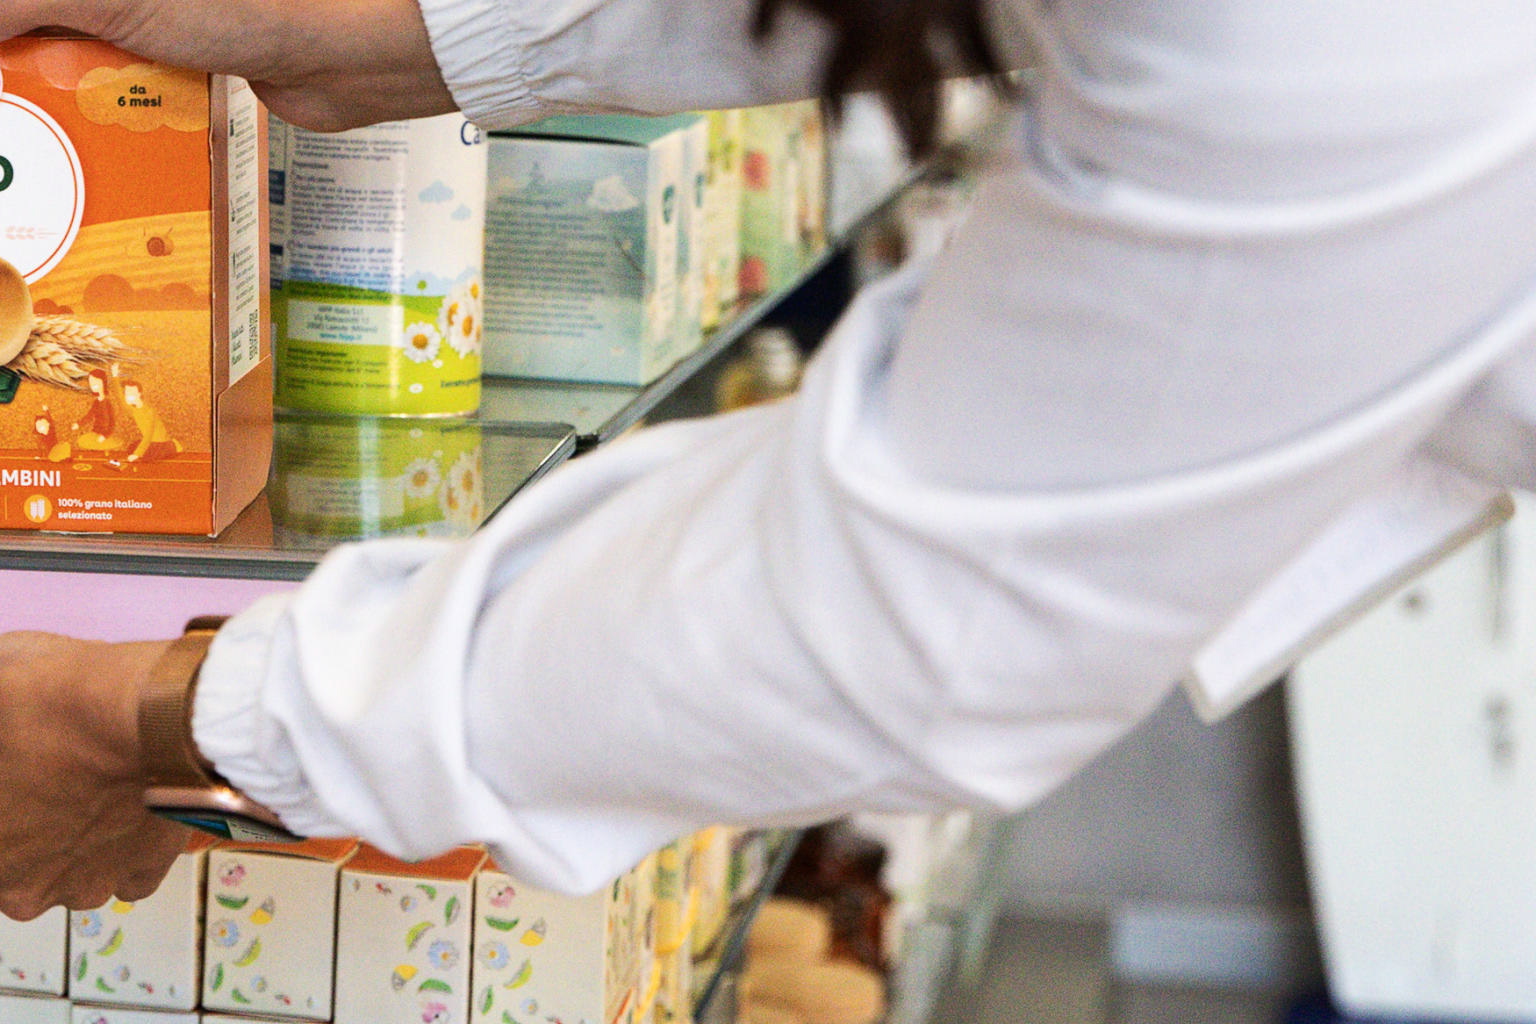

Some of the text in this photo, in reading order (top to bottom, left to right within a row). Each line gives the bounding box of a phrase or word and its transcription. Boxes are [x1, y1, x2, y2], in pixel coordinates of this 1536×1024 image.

[129, 84, 147, 96] da
[117, 95, 162, 108] 6 mesi
[58, 498, 153, 510] 100% grano italiano
[58, 511, 112, 520] selezionato
